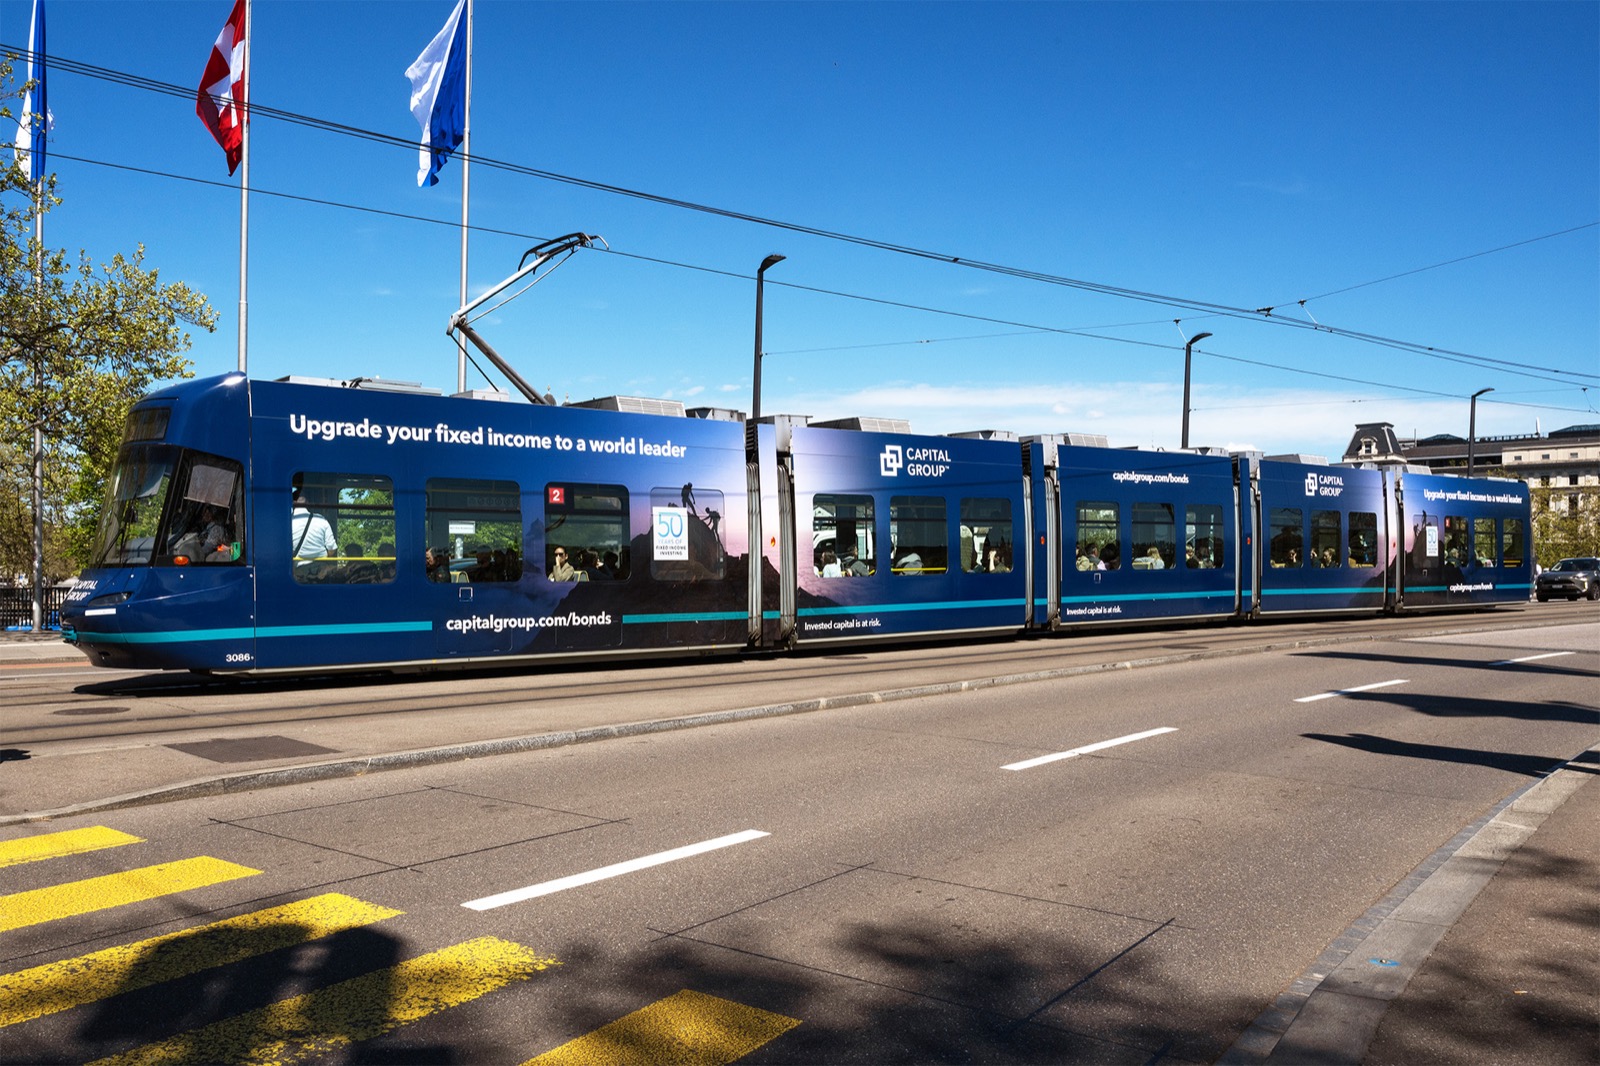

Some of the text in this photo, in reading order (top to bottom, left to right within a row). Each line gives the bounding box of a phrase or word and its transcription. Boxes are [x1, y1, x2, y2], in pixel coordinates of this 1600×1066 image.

[289, 413, 687, 457] Upgrade your fixed income to a world leader
[906, 447, 951, 462] CAPITAL
[1112, 470, 1189, 484] capitalgroup.com/bonds
[1318, 474, 1344, 486] CAPITAL
[552, 489, 561, 502] 2
[1423, 488, 1445, 502] Upgrade
[657, 511, 683, 538] 50
[446, 610, 612, 634] capitalgroup.com/bonds
[804, 618, 881, 631] Invested capital is at risk.
[225, 653, 250, 662] 3086
